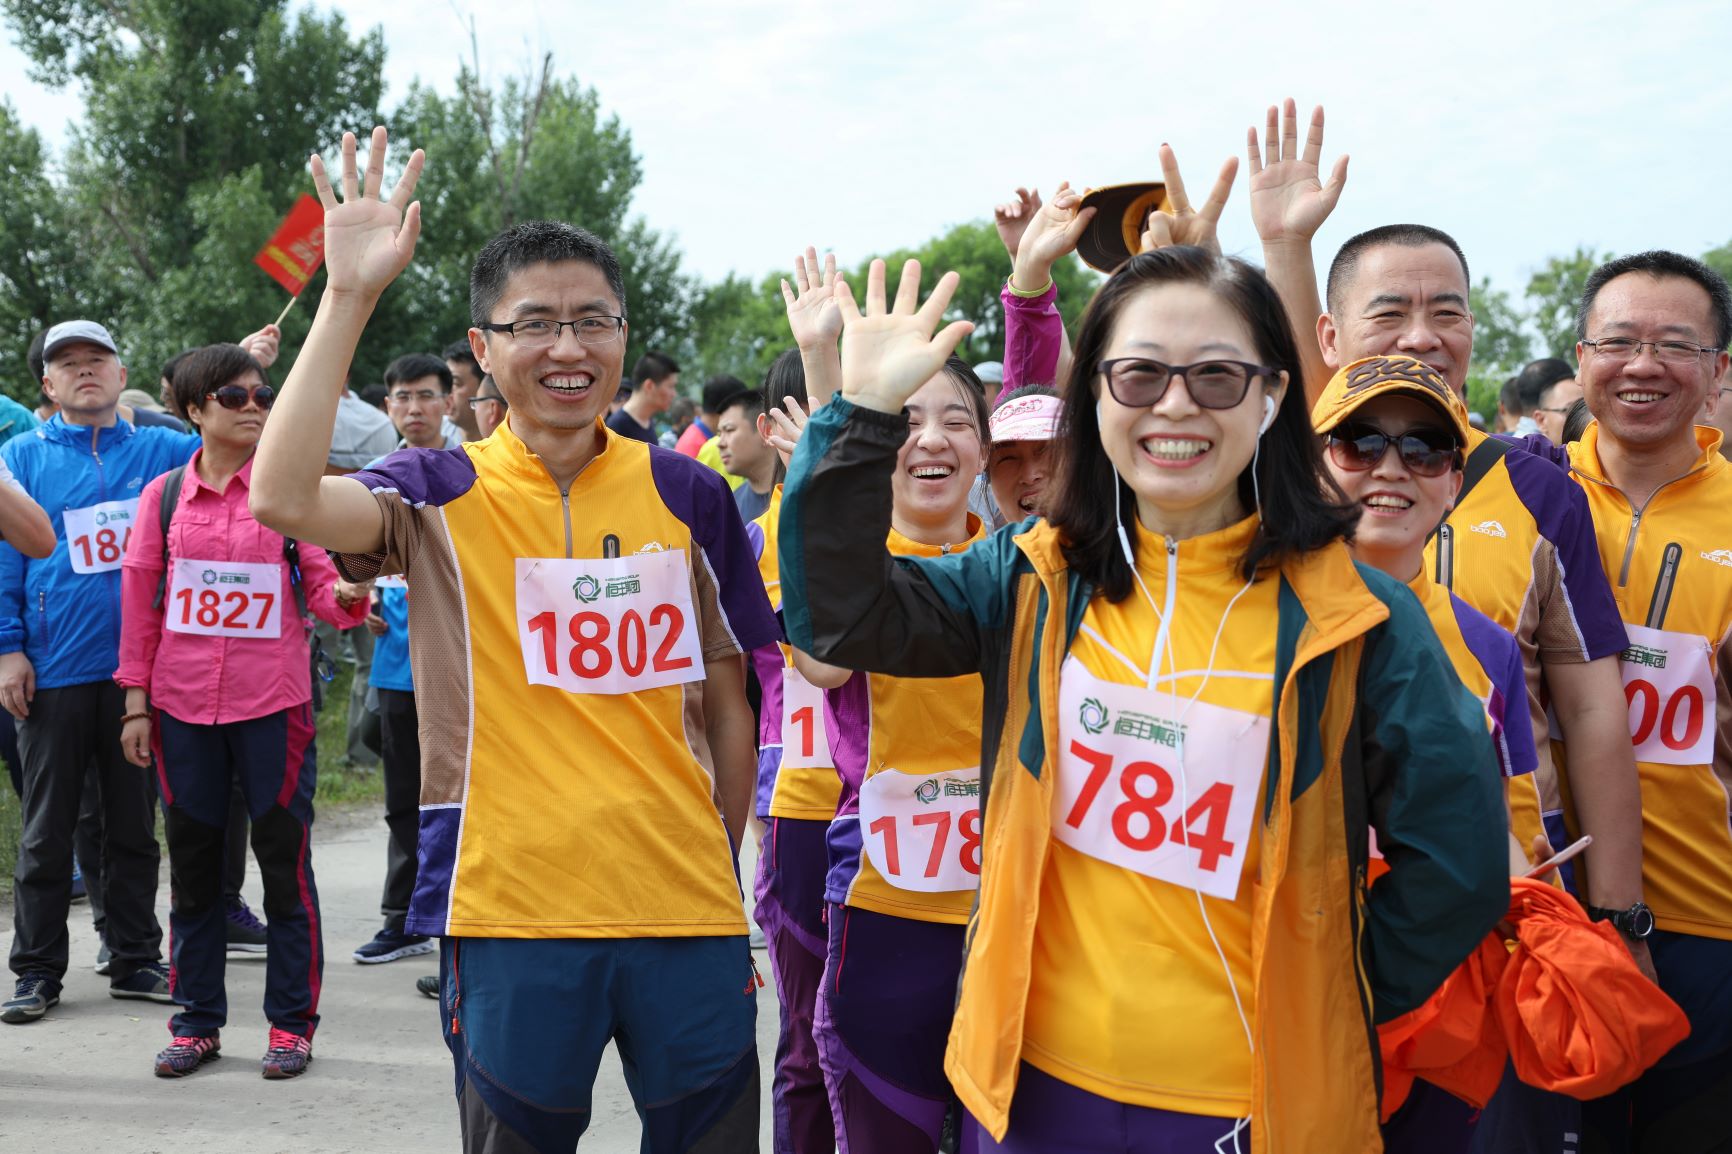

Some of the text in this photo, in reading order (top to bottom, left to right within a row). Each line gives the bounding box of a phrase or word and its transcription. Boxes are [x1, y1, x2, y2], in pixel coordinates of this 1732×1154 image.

[176, 588, 274, 630] 1827
[527, 603, 693, 679] 1802
[1066, 739, 1235, 872] 784
